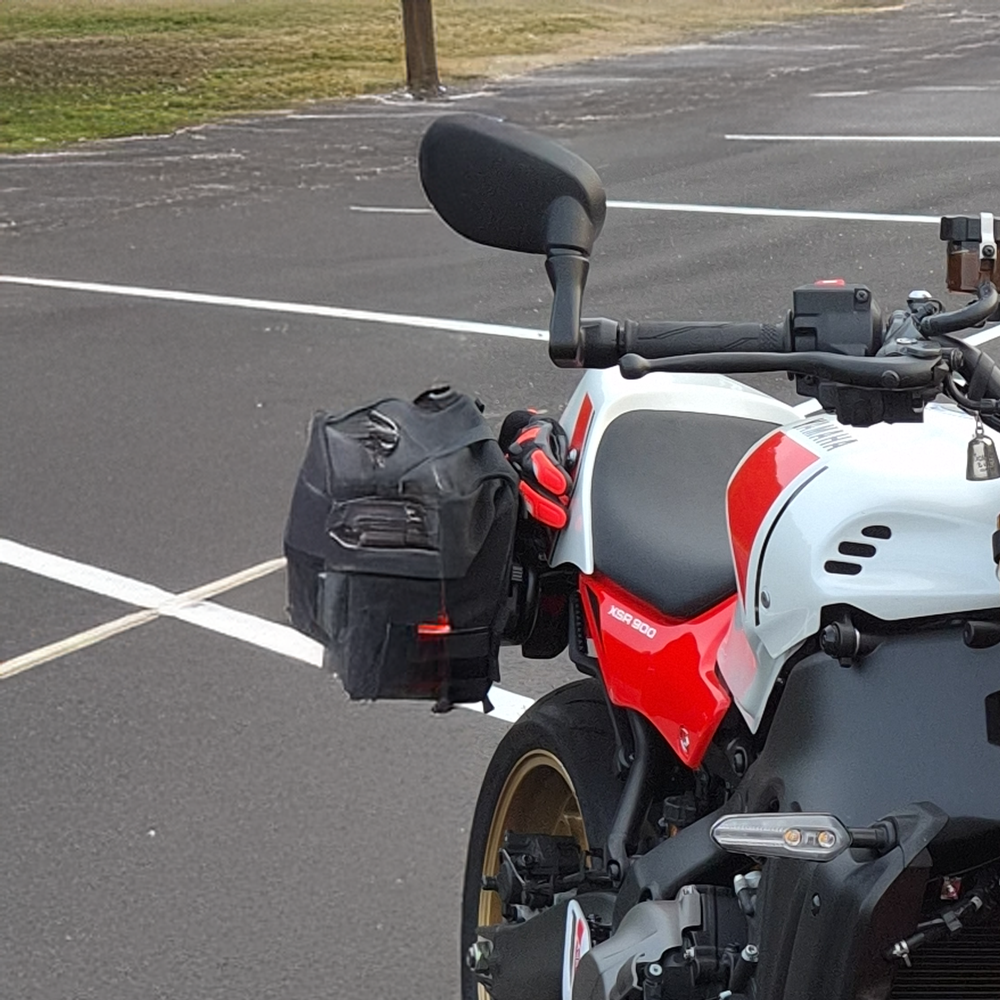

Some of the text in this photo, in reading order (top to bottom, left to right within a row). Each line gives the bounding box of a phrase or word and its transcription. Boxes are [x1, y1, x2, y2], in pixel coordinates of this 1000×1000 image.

[792, 417, 858, 452] YAMAHA
[607, 604, 657, 639] XSR 900
